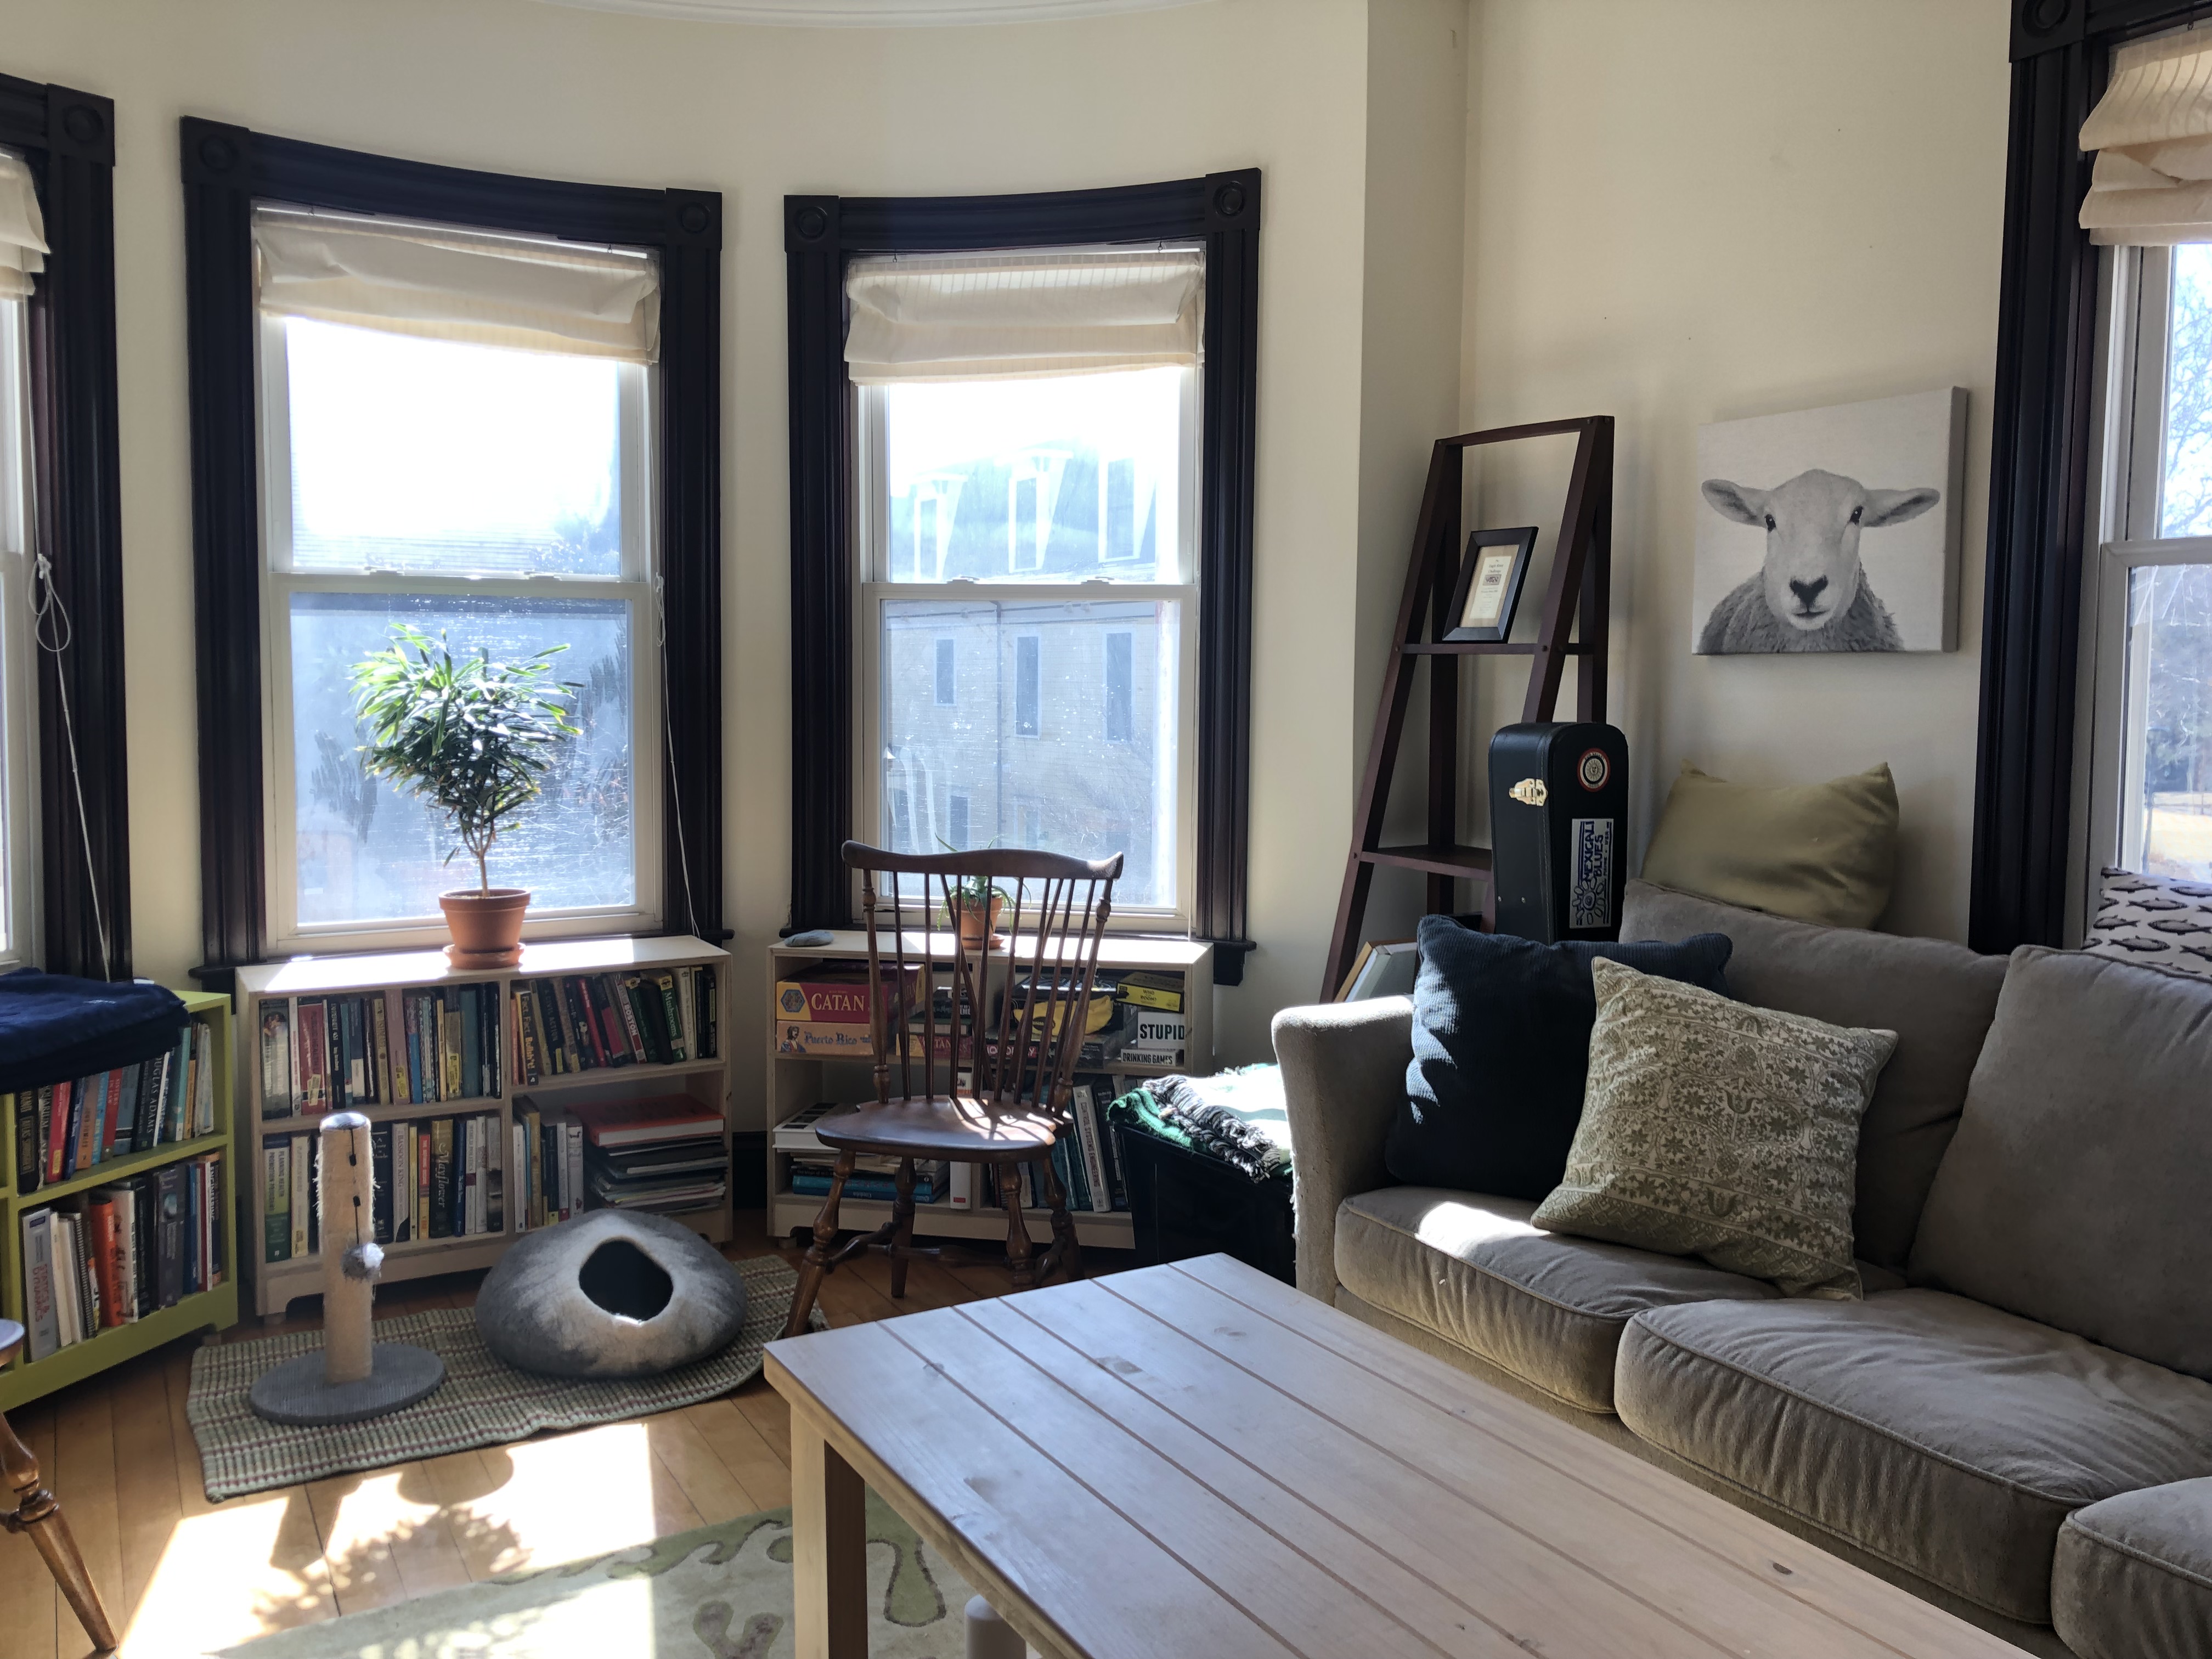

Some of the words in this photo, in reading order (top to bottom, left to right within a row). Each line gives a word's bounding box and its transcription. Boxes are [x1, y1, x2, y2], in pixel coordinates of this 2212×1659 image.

[1584, 821, 1595, 881] MEXICALI
[1592, 834, 1604, 878] BLUES
[624, 1004, 637, 1036] BOSTON
[664, 991, 677, 1037] Mushrooms
[811, 992, 865, 1012] CATAN
[549, 1017, 558, 1042] ACTION
[804, 1031, 833, 1045] Puerto
[836, 1032, 857, 1045] Rico
[1139, 1023, 1184, 1040] STUPID
[1122, 1052, 1152, 1063] DRINKING
[1152, 1054, 1172, 1064] GAMES
[146, 1097, 157, 1133] ADAMS
[435, 1142, 449, 1208] Mayflower
[33, 1267, 42, 1322] DYNAMICS
[40, 1263, 49, 1303] STATICS
